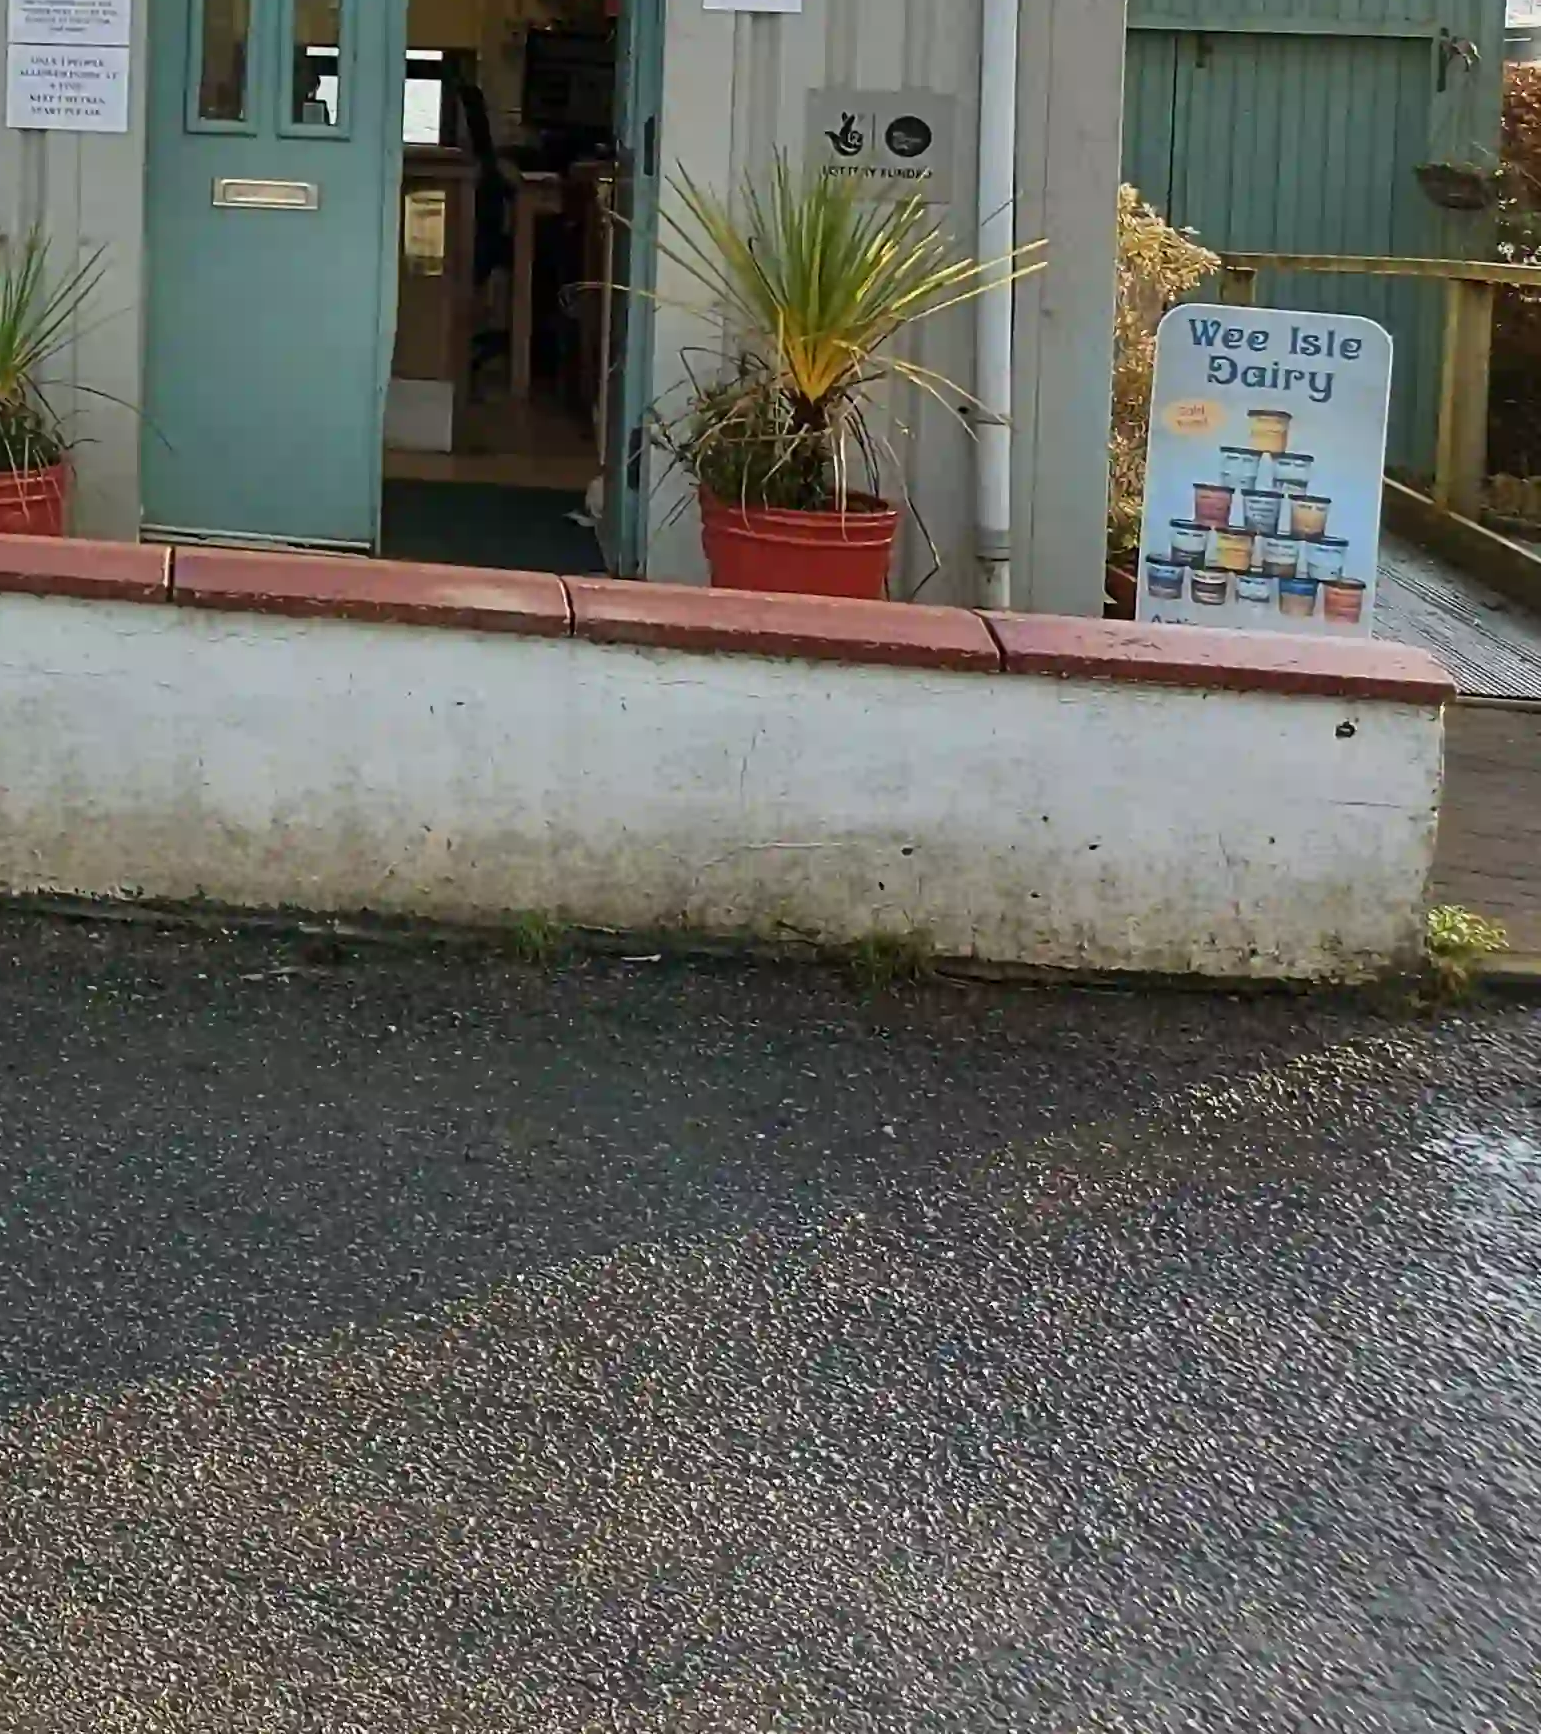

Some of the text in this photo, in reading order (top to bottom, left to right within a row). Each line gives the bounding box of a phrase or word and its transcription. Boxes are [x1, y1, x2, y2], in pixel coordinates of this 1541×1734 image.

[1188, 318, 1363, 361] Wee Isle
[1208, 355, 1335, 404] Dairy
